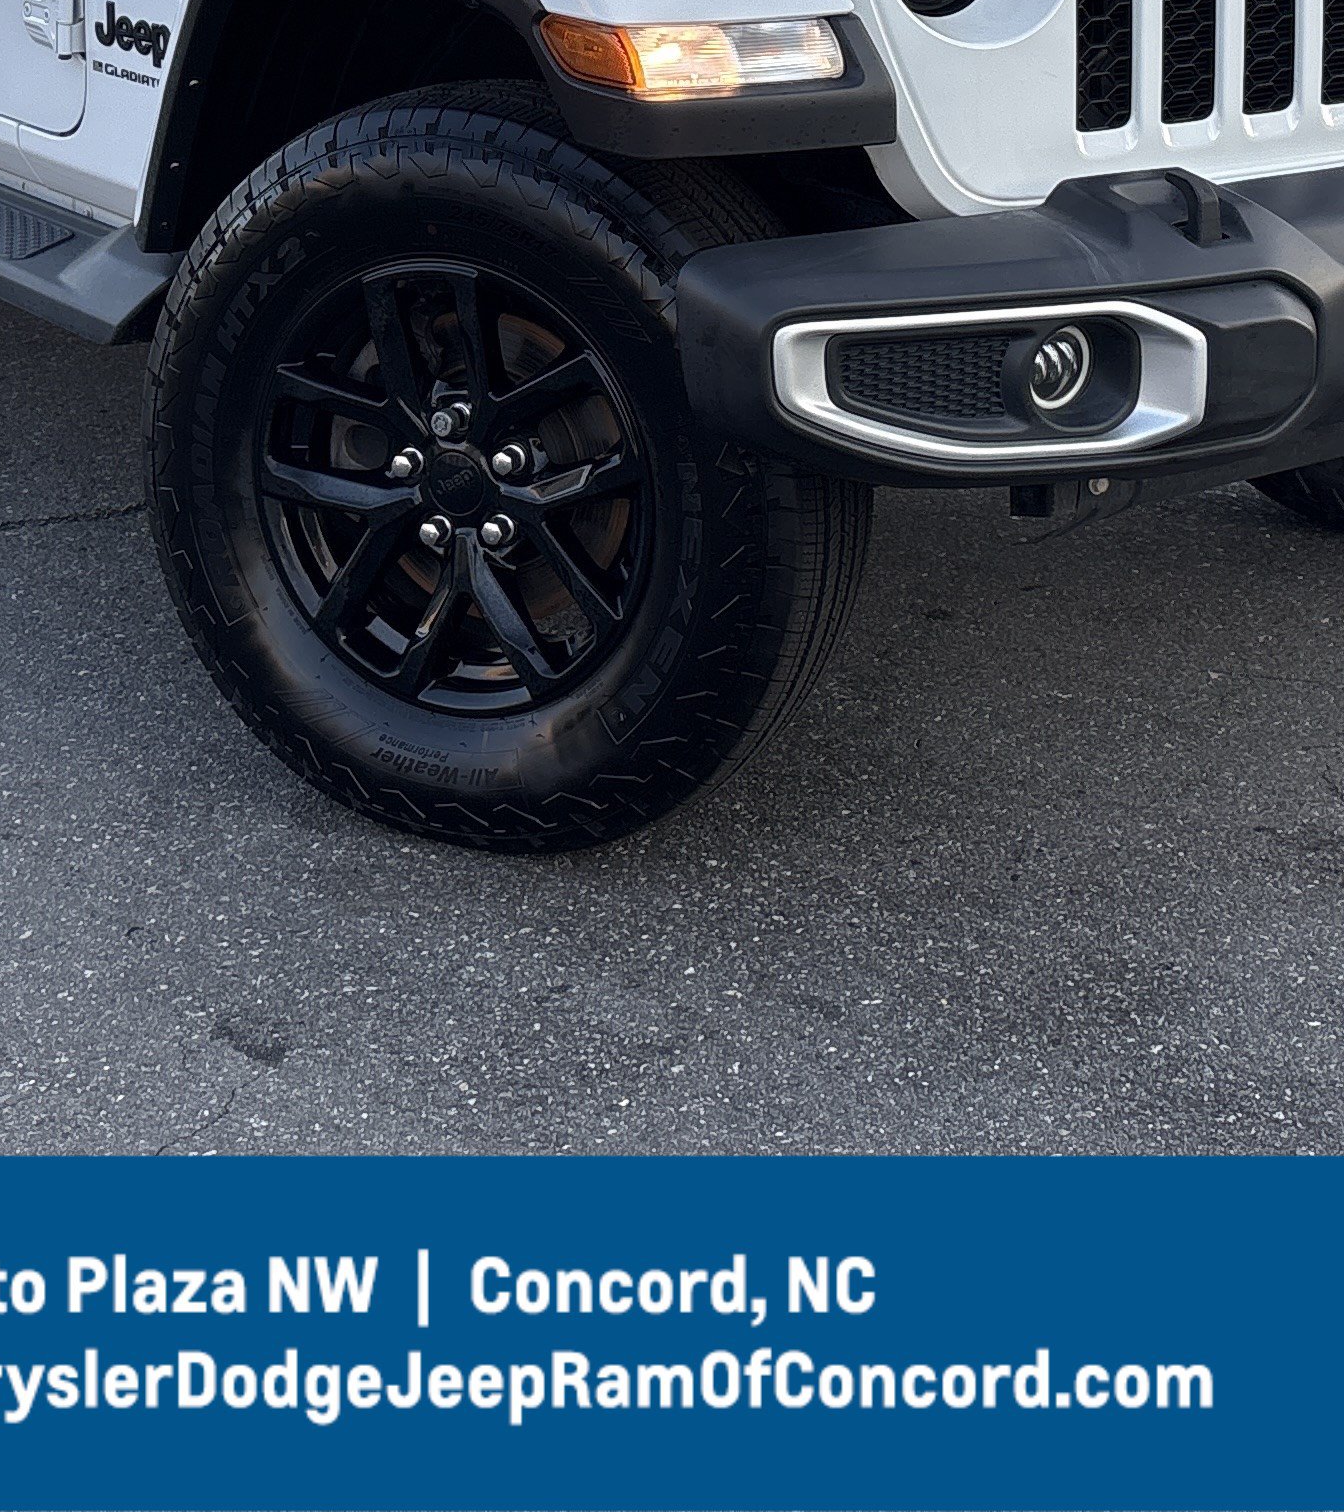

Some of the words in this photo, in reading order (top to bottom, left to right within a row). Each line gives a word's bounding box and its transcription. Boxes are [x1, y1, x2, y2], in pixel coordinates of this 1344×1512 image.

[95, 0, 172, 69] Jeep
[104, 62, 160, 88] GLADIAT
[436, 468, 474, 496] Jeep
[618, 462, 704, 715] NEXEN
[379, 733, 451, 763] Performance
[370, 747, 499, 787] All-Weather
